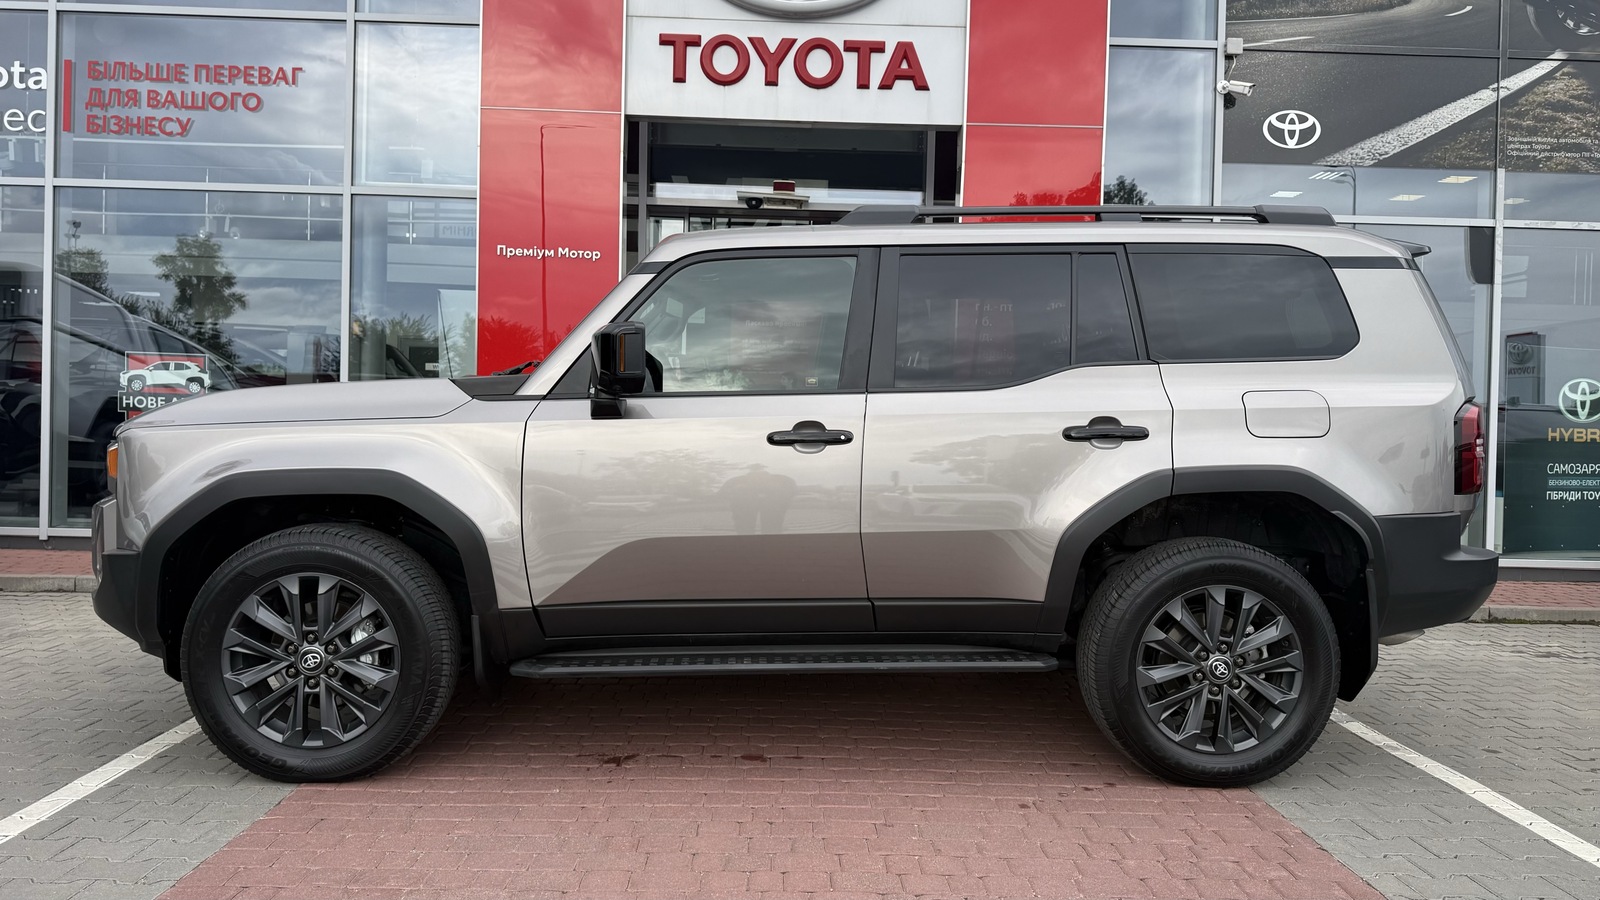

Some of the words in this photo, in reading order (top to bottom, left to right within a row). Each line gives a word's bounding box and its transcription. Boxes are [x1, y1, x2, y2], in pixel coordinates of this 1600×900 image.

[659, 32, 930, 91] TOYOTA
[86, 60, 188, 84] БІЛЬШЕ
[194, 64, 304, 88] ПЕРЕВАГ
[85, 87, 139, 110] ДЛЯ
[146, 91, 264, 113] ВАШОГО
[86, 114, 194, 138] БІЗНЕСУ
[1507, 149, 1540, 157] Офіційний
[496, 244, 554, 260] Преміум
[557, 246, 601, 262] Мотор
[122, 395, 167, 408] НОВЕ
[1546, 491, 1581, 502] ГІБРИДИ
